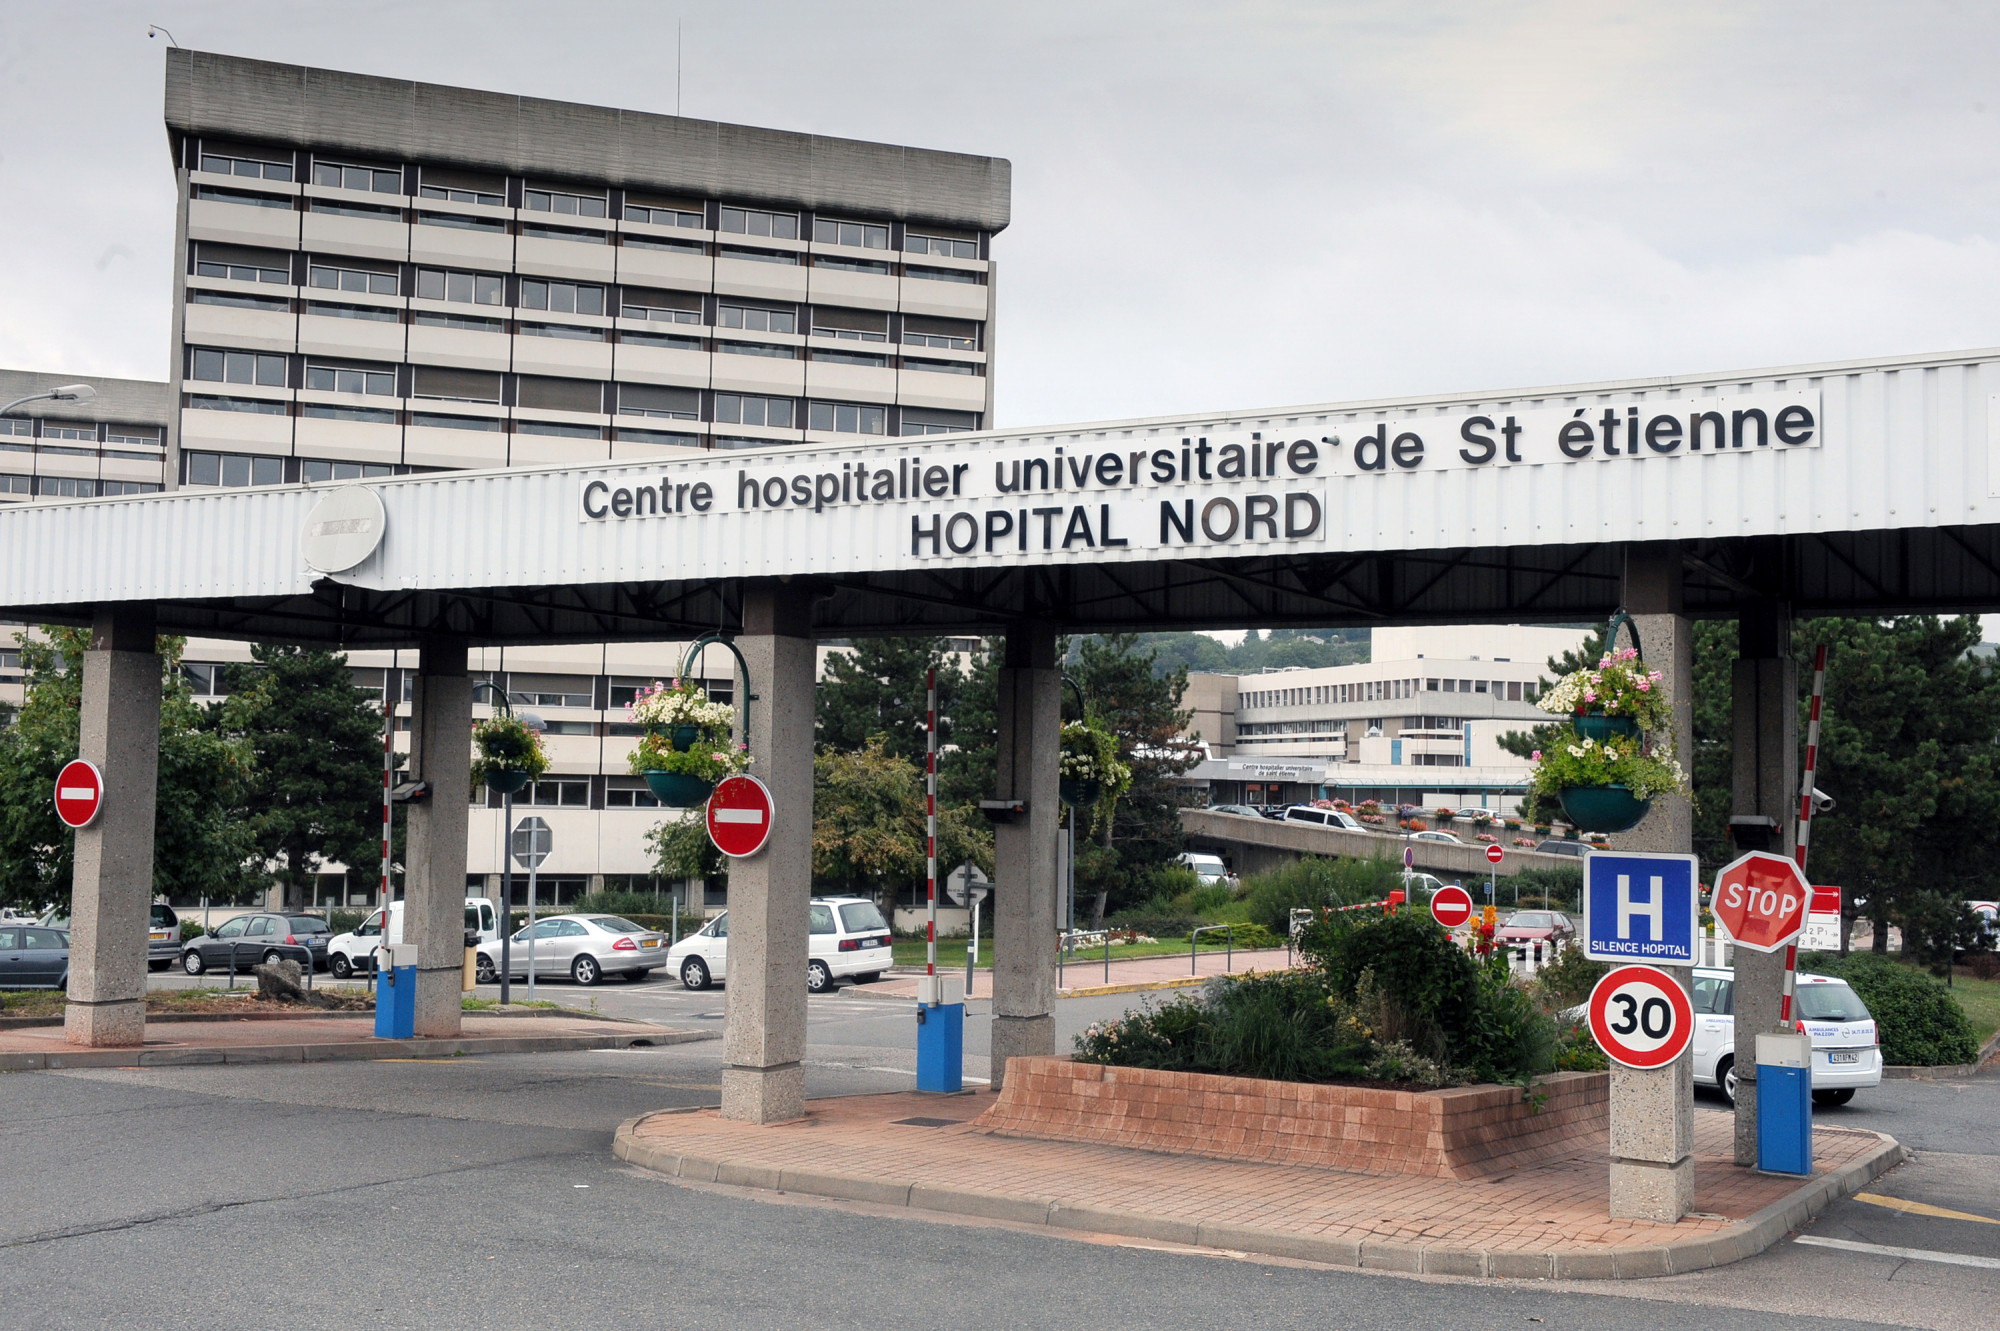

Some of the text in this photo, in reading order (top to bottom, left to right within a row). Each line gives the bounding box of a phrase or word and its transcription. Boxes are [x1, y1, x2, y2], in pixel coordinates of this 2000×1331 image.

[583, 405, 1815, 519] Centre hospitalier universitaire de St étienne
[912, 492, 1322, 556] HOPITAL NORD
[1617, 874, 1663, 941] H
[1724, 882, 1797, 919] STOP
[1591, 941, 1689, 956] SILENCE HOPITAL
[1610, 993, 1672, 1040] 30
